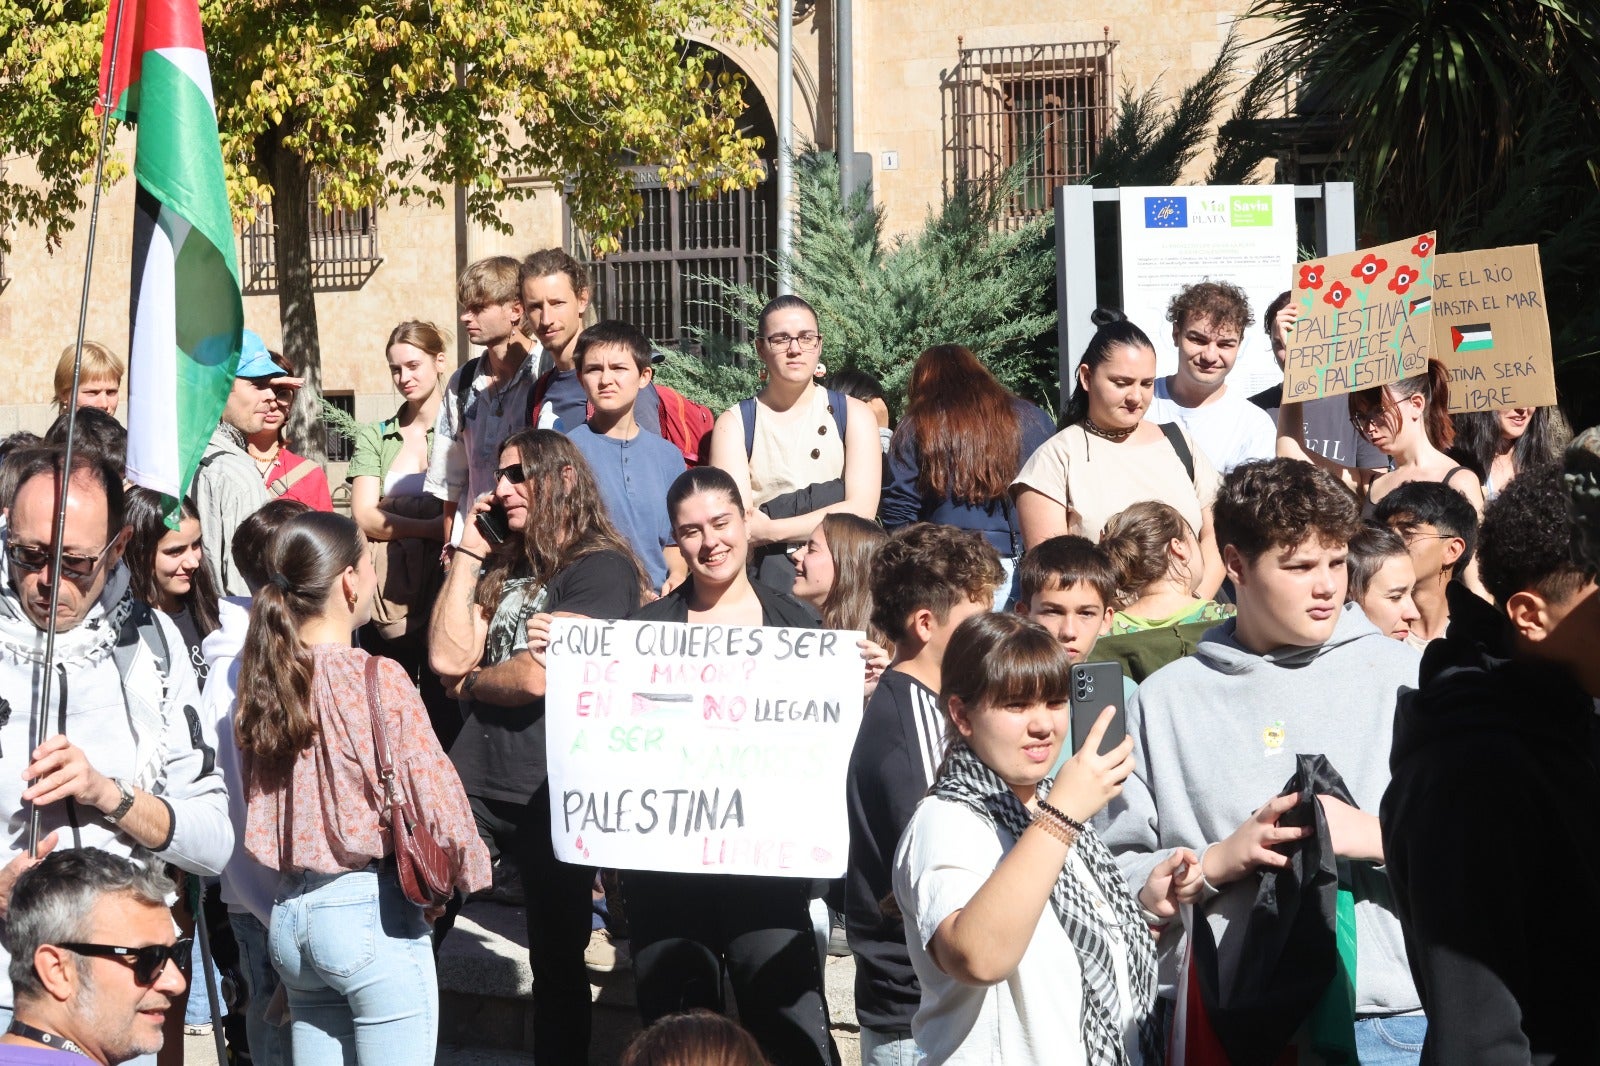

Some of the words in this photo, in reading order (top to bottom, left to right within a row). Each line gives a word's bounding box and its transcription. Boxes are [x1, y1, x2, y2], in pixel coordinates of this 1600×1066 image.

[1233, 200, 1269, 213] Savia
[1459, 271, 1480, 286] EL
[1434, 300, 1479, 317] HASTA
[1483, 296, 1501, 311] EL
[1506, 290, 1542, 308] MAR
[1295, 299, 1408, 343] PALESTINA
[1288, 330, 1392, 370] PERTENECE
[1401, 325, 1416, 348] A
[1287, 372, 1319, 399] L@S
[1325, 345, 1427, 393] PALESTIN@S
[1446, 365, 1487, 383] STINA
[1493, 355, 1537, 379] SERÁ
[1447, 384, 1517, 410] LIBRE
[635, 623, 764, 658] QUIERES
[774, 628, 838, 661] SER
[582, 659, 621, 685] DE
[576, 691, 613, 718] EN
[702, 694, 748, 722] NO
[754, 697, 841, 724] LLEGAN
[569, 728, 588, 755] A
[607, 725, 665, 753] SER
[562, 786, 746, 837] PALESTINA
